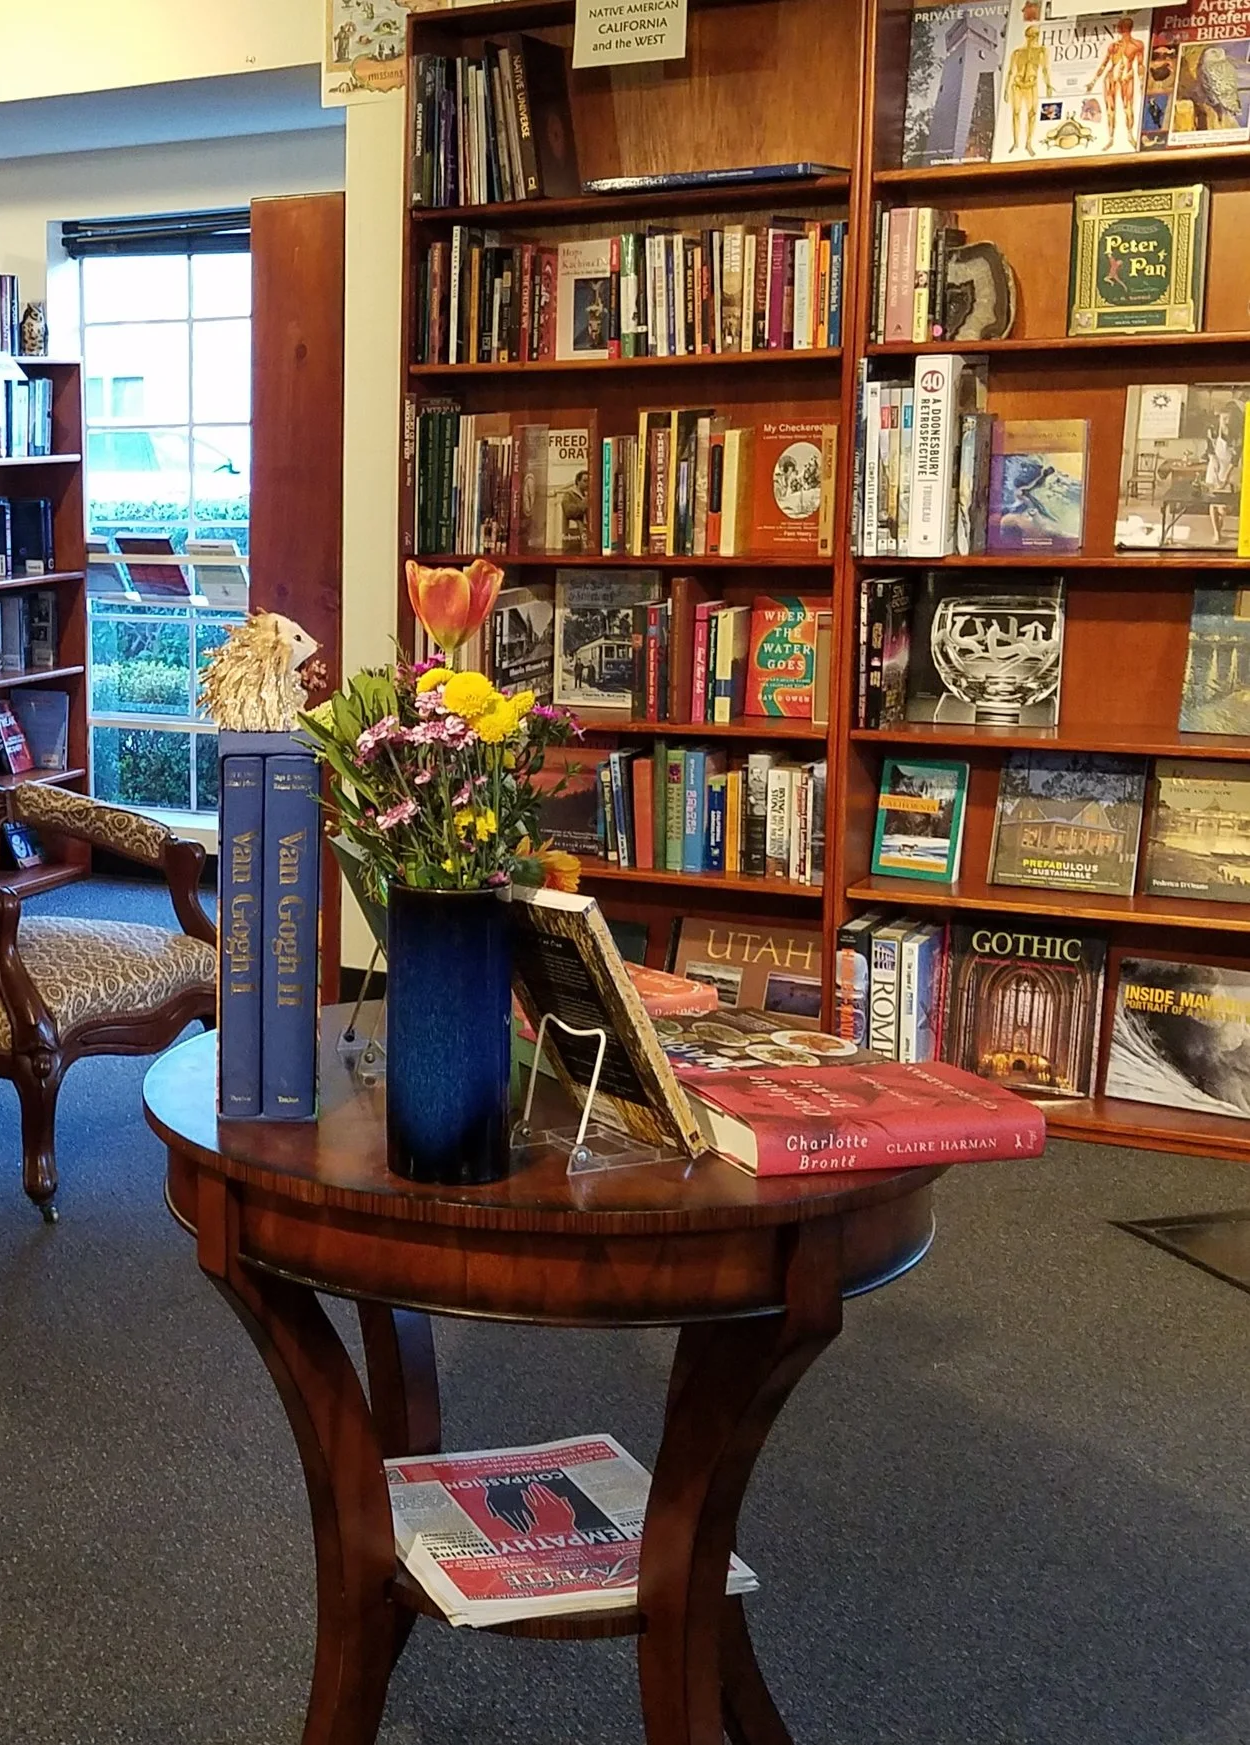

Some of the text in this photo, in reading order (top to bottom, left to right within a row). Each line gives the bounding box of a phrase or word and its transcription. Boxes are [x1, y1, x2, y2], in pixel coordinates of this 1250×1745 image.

[589, 0, 679, 19] NATIVE AMERICAN
[915, 9, 963, 22] PRIVATE
[598, 17, 668, 35] CALIFORNIA
[1163, 14, 1206, 29] Photo
[1041, 23, 1117, 46] HUMAN
[1197, 24, 1247, 40] BIRDS
[592, 34, 666, 51] and the WEST
[1054, 42, 1102, 62] BODY
[512, 55, 530, 138] NATIVE UNIVERSE
[731, 233, 740, 272] TRAGIC
[1104, 235, 1158, 254] Peter
[1129, 258, 1167, 278] Pan
[921, 370, 944, 391] 40
[764, 424, 776, 434] My
[918, 398, 930, 476] RETROSPECTIVE
[929, 409, 940, 476] DOONESBURY
[867, 462, 875, 494] COMPLETE
[922, 485, 932, 523] TRUDEAU
[764, 611, 815, 622] WHERE
[774, 627, 802, 638] THE
[763, 643, 810, 655] WATER
[767, 659, 805, 670] GOES
[785, 695, 811, 703] OWEN
[881, 800, 936, 811] CALIFORNIA
[1022, 858, 1099, 873] PREFABULOUS
[225, 832, 258, 996] Van Gogh I
[272, 828, 307, 1008] Van Gogh II
[707, 929, 814, 969] UTAH
[972, 930, 1082, 962] GOTHIC
[1125, 984, 1175, 1005] INSIDE
[1124, 1000, 1170, 1014] PORTRAIT
[1171, 1005, 1184, 1015] OF
[1186, 1008, 1193, 1017] A
[787, 1133, 869, 1151] Charlotte
[886, 1137, 998, 1153] CLAIRE HARMAN
[799, 1154, 857, 1169] Brontë
[443, 1470, 565, 1490] COMPASSION
[426, 1541, 489, 1552] Homeless
[498, 1527, 619, 1554] EMPATHY
[428, 1548, 496, 1560] Helping
